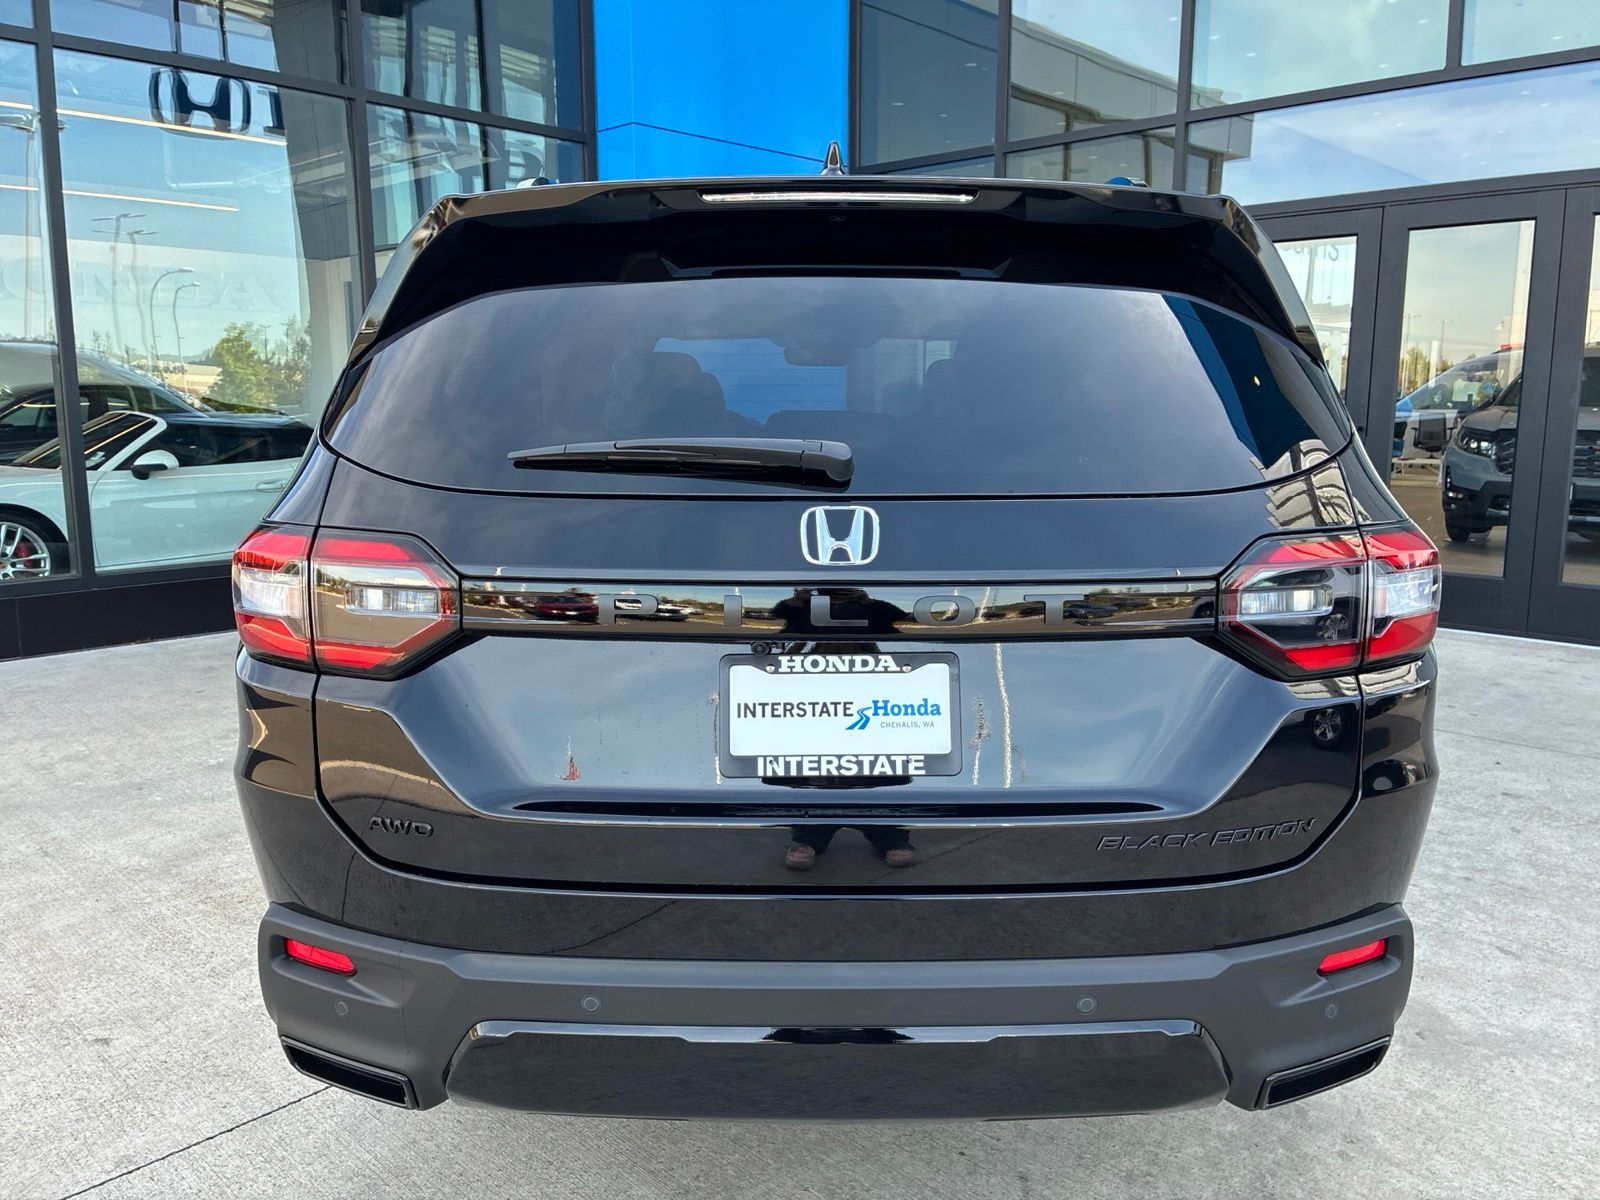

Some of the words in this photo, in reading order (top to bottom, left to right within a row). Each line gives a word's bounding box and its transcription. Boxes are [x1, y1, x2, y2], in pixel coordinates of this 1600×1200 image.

[597, 593, 1085, 627] PILOT
[778, 655, 900, 673] HONDA
[736, 701, 854, 718] INTERSTATE
[872, 698, 942, 717] Honda
[880, 721, 921, 729] CHEHALIS,
[923, 721, 935, 729] WA
[757, 755, 926, 777] INTERSTATE
[369, 816, 434, 838] AWD
[1097, 831, 1208, 851] BLACK
[1209, 818, 1316, 847] EDITION
